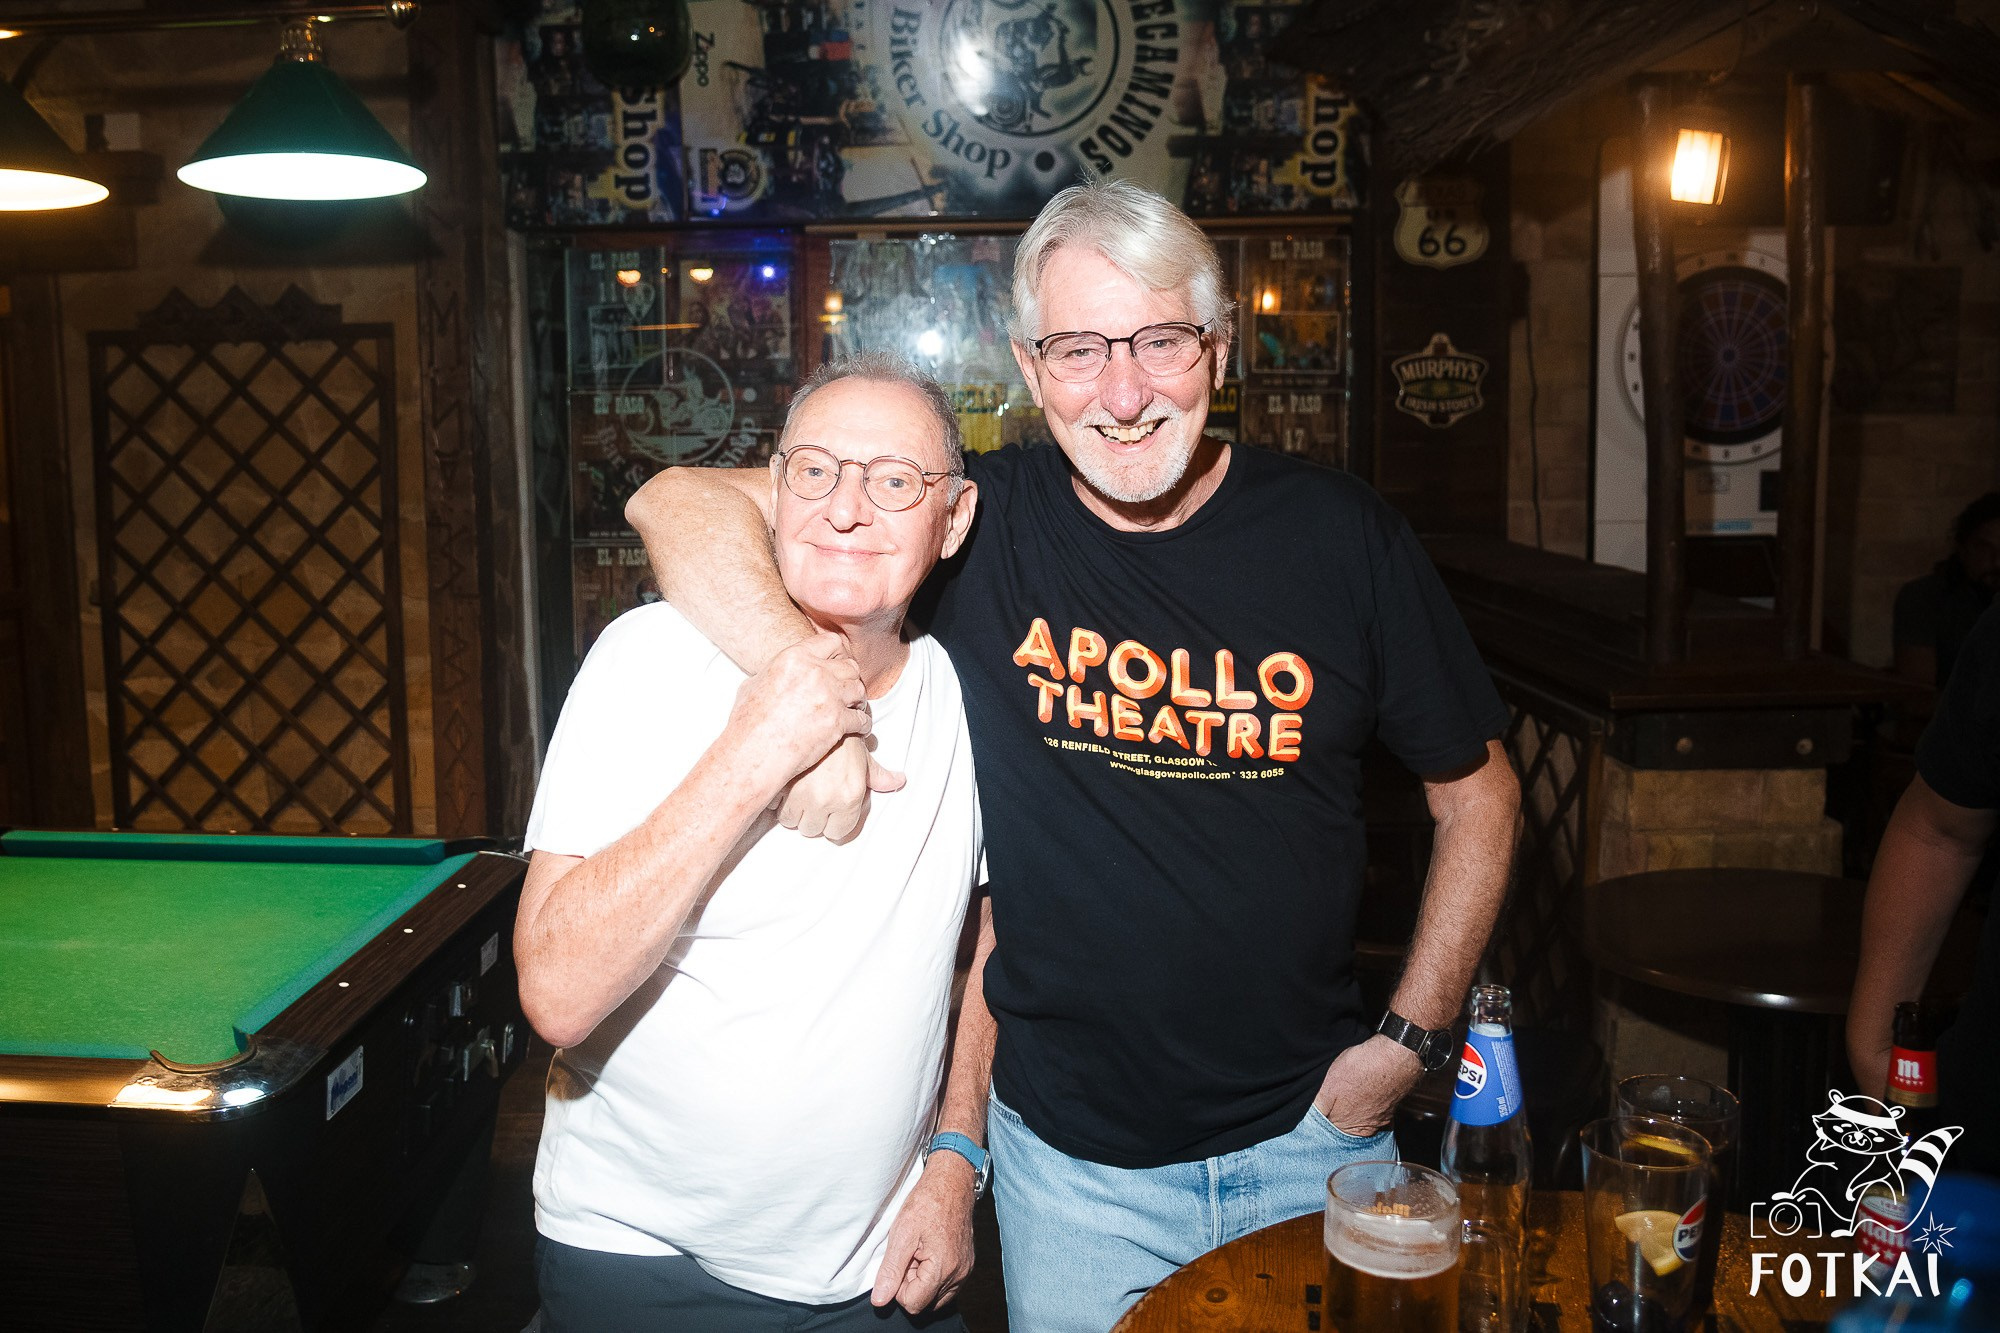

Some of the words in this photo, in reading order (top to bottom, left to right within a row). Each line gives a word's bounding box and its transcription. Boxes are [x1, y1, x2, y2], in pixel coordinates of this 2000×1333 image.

[889, 8, 926, 107] Biker
[922, 110, 1010, 179] Shop
[1302, 97, 1348, 187] hop
[1418, 225, 1465, 256] 66
[1267, 394, 1284, 414] EL
[1289, 393, 1322, 414] PASO
[597, 549, 612, 565] EL
[1012, 617, 1314, 711] APOLLO
[1027, 672, 1303, 762] THEATRE
[1061, 739, 1111, 755] RENFIELD
[1112, 750, 1152, 764] STREET,
[1154, 756, 1205, 767] GLASGOW
[1110, 761, 1231, 780] www.glasgowapollo.com
[1239, 770, 1258, 780] 332
[1260, 767, 1285, 779] 6055
